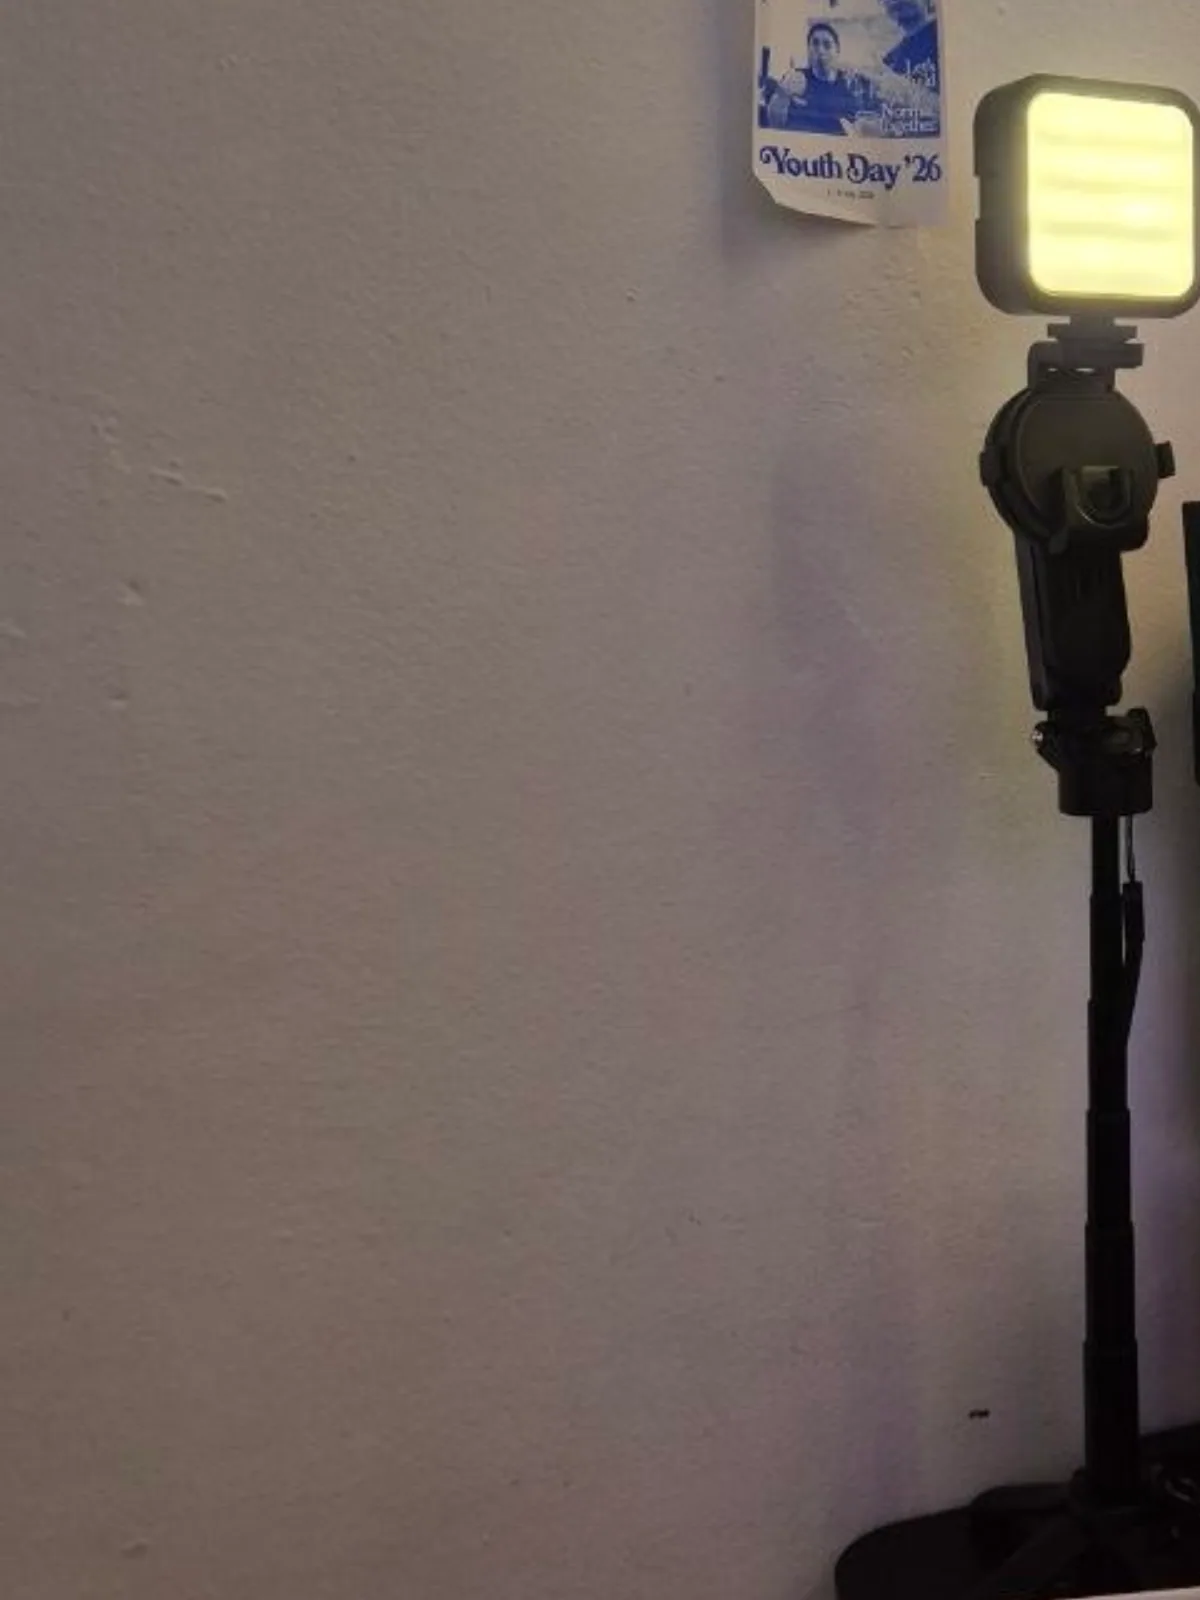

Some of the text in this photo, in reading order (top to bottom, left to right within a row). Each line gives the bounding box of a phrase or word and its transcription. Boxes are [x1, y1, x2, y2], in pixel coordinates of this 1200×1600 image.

[760, 146, 941, 190] Youth Day '26
